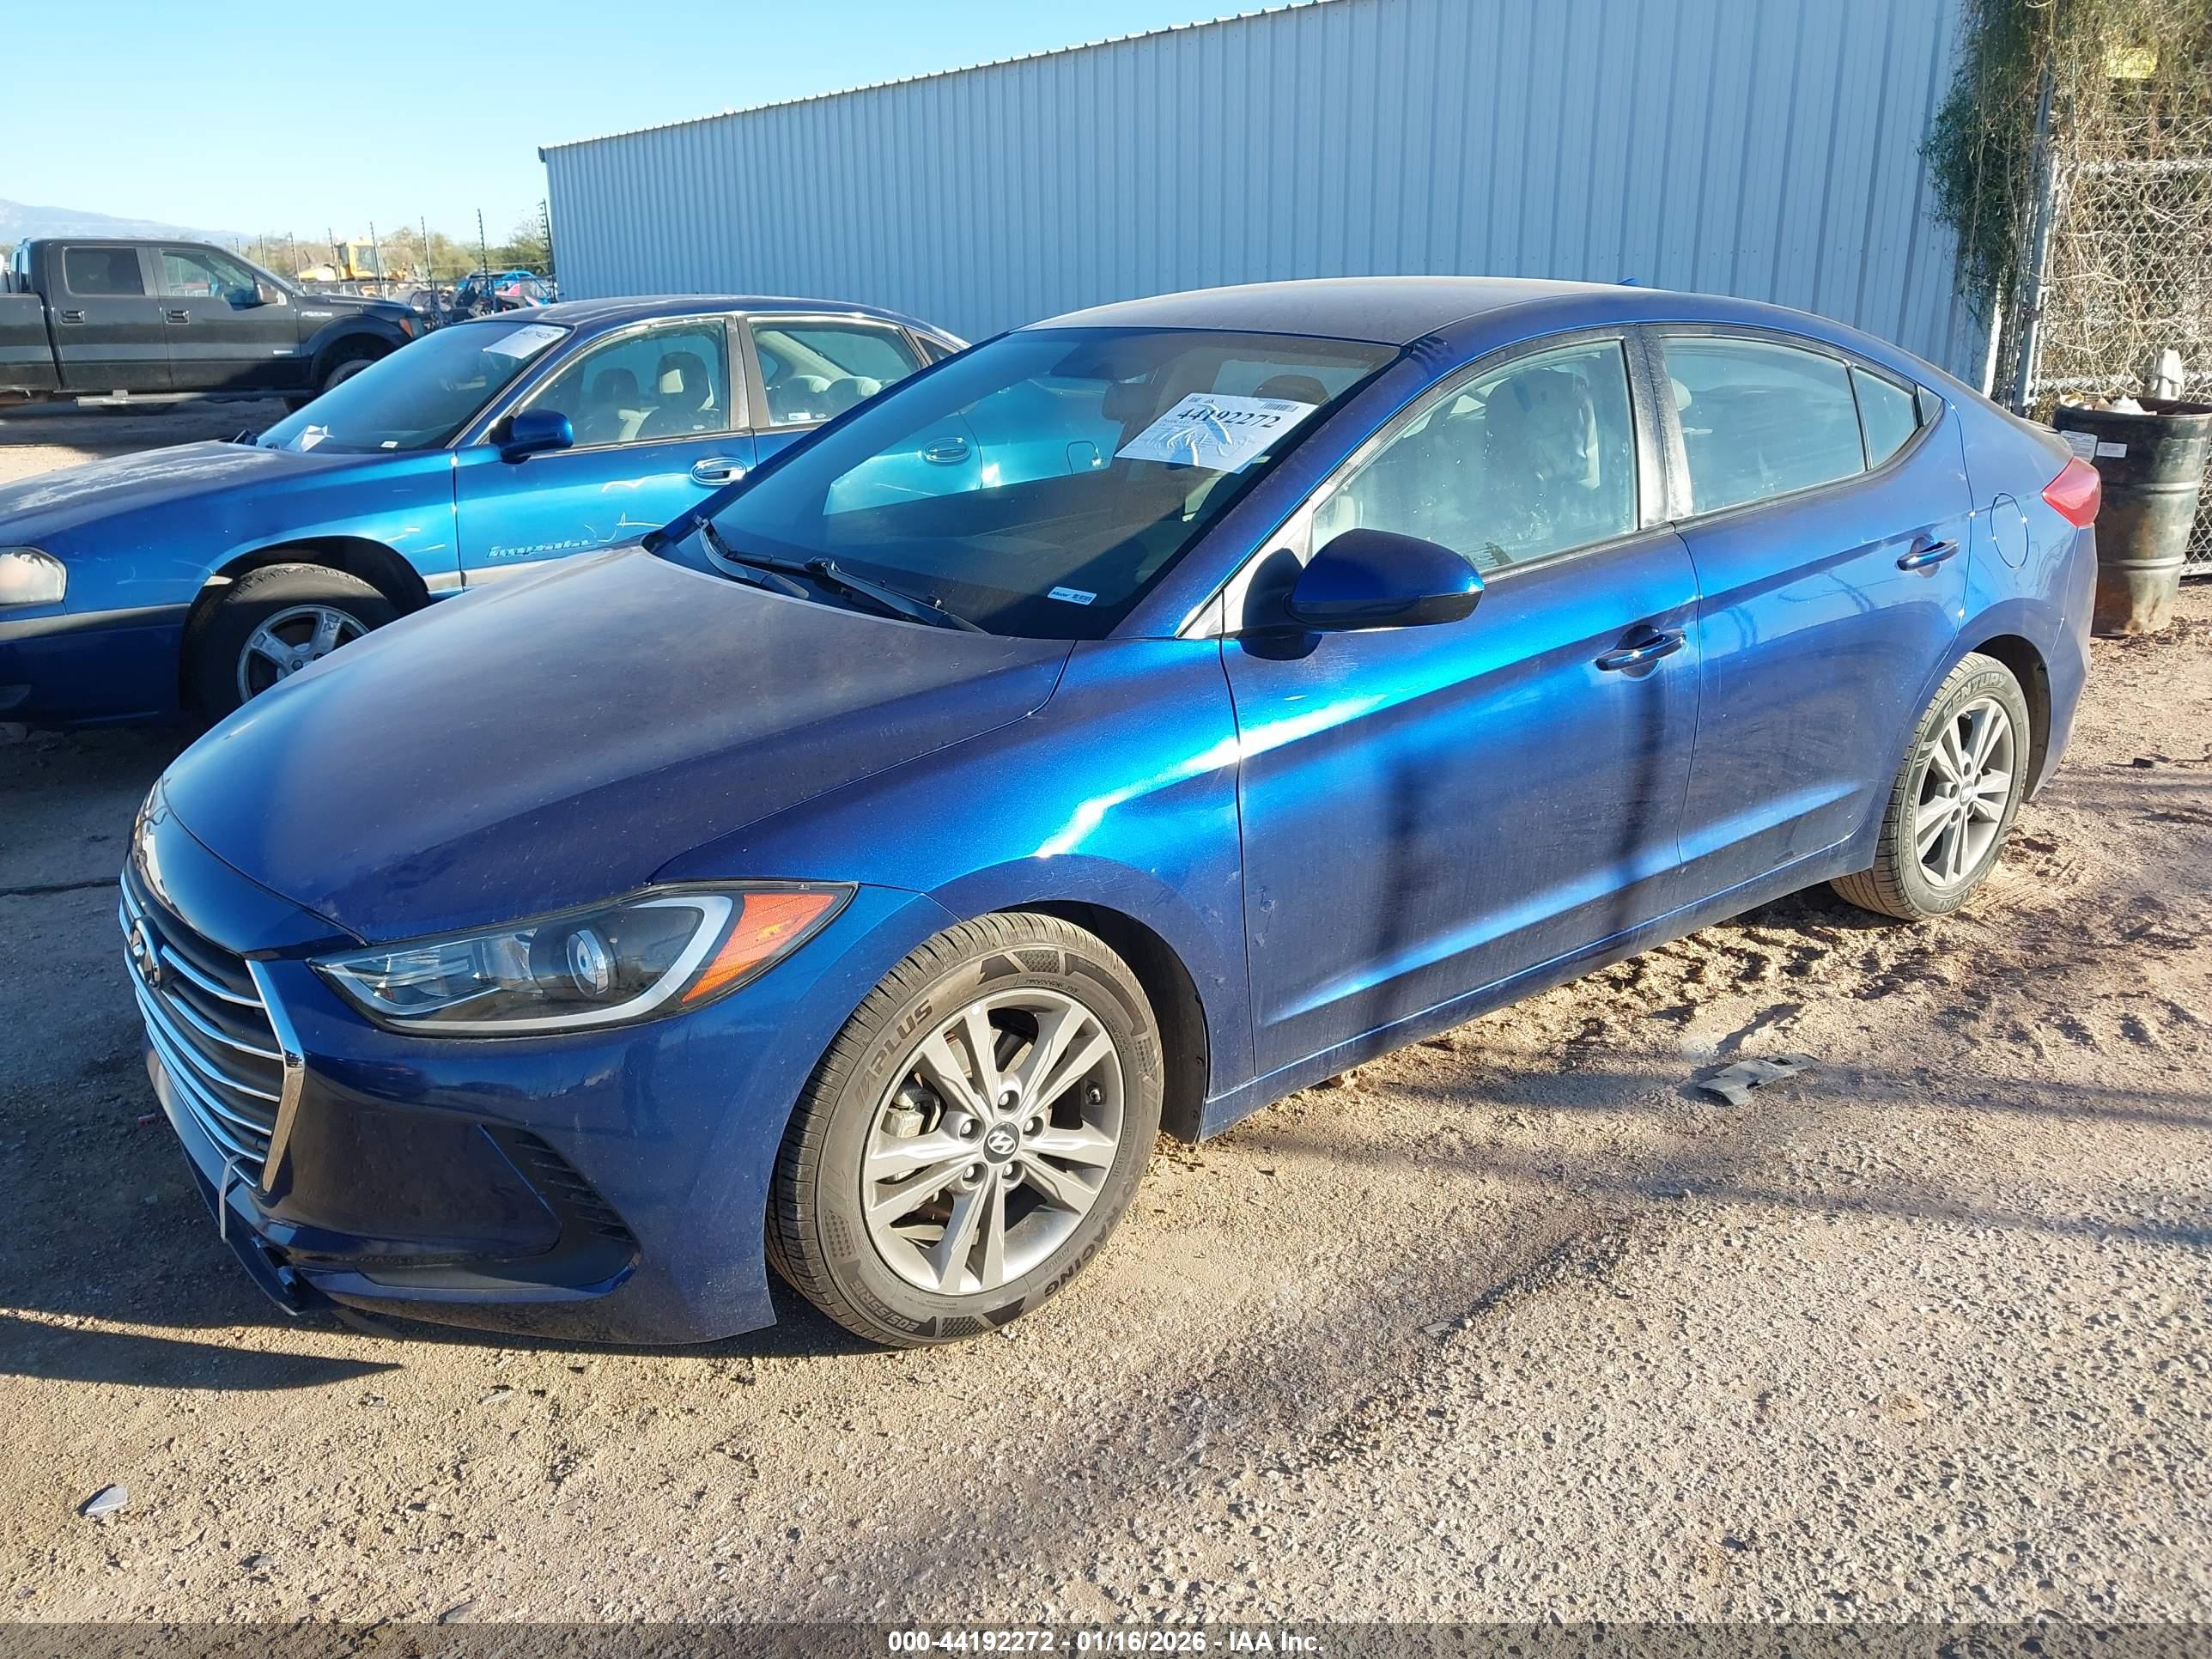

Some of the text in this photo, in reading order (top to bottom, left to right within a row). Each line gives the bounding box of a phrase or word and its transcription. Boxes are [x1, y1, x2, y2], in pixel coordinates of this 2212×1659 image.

[1176, 407, 1281, 428] 44192272
[1943, 672, 2008, 720] SENTURY
[1044, 1206, 1123, 1297] RACING
[849, 1279, 921, 1333] 205/55R16
